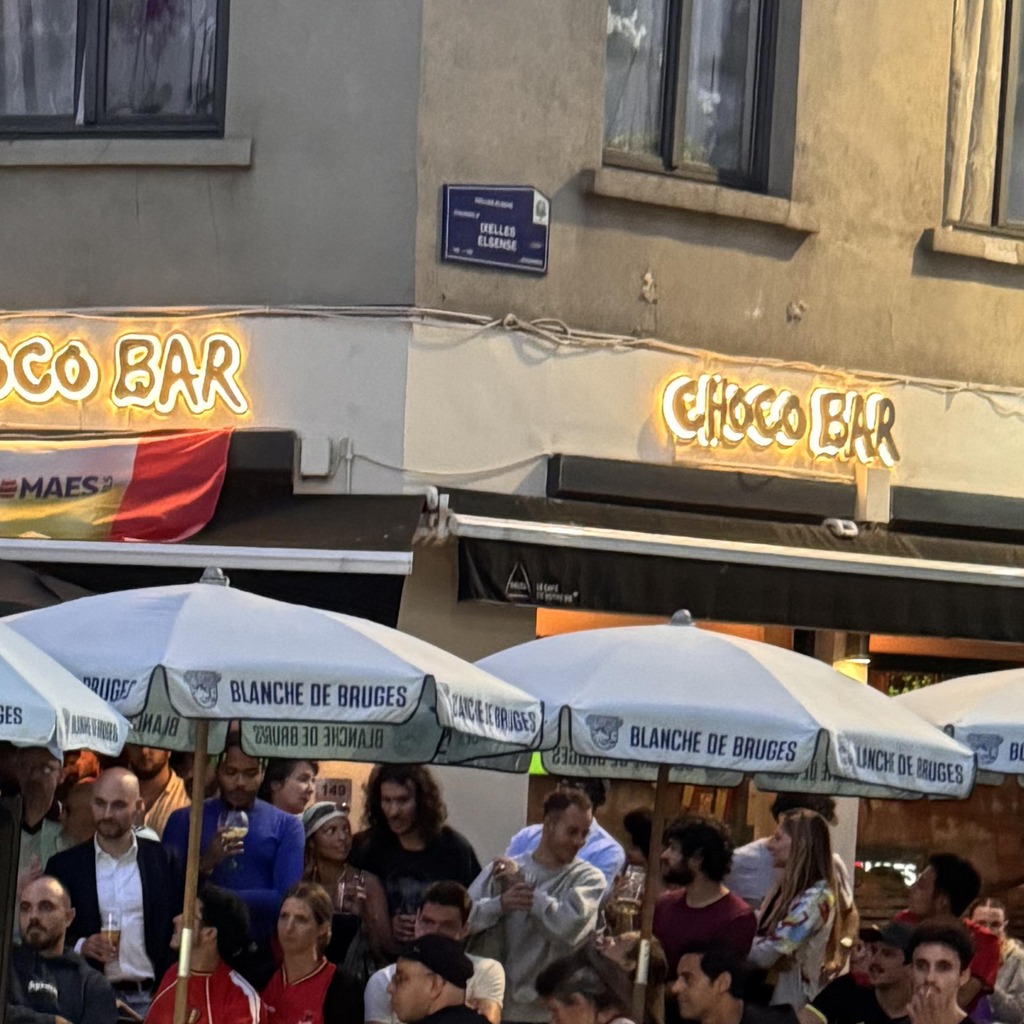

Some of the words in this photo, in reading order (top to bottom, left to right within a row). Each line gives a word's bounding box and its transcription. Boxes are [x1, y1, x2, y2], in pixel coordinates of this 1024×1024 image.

[480, 222, 516, 238] IXELLES
[112, 332, 250, 414] BAR
[663, 374, 807, 447] CHOCO
[809, 387, 900, 467] BAR
[19, 476, 99, 499] MAES
[230, 679, 305, 707] BLANCHE
[310, 683, 332, 707] DE
[338, 685, 407, 708] BRUGES
[630, 726, 701, 752] BLANCHE
[707, 734, 727, 755] DE
[732, 737, 798, 761] BRUGES
[898, 754, 912, 776] DE
[916, 757, 964, 784] BRUGES
[321, 784, 346, 796] 149
